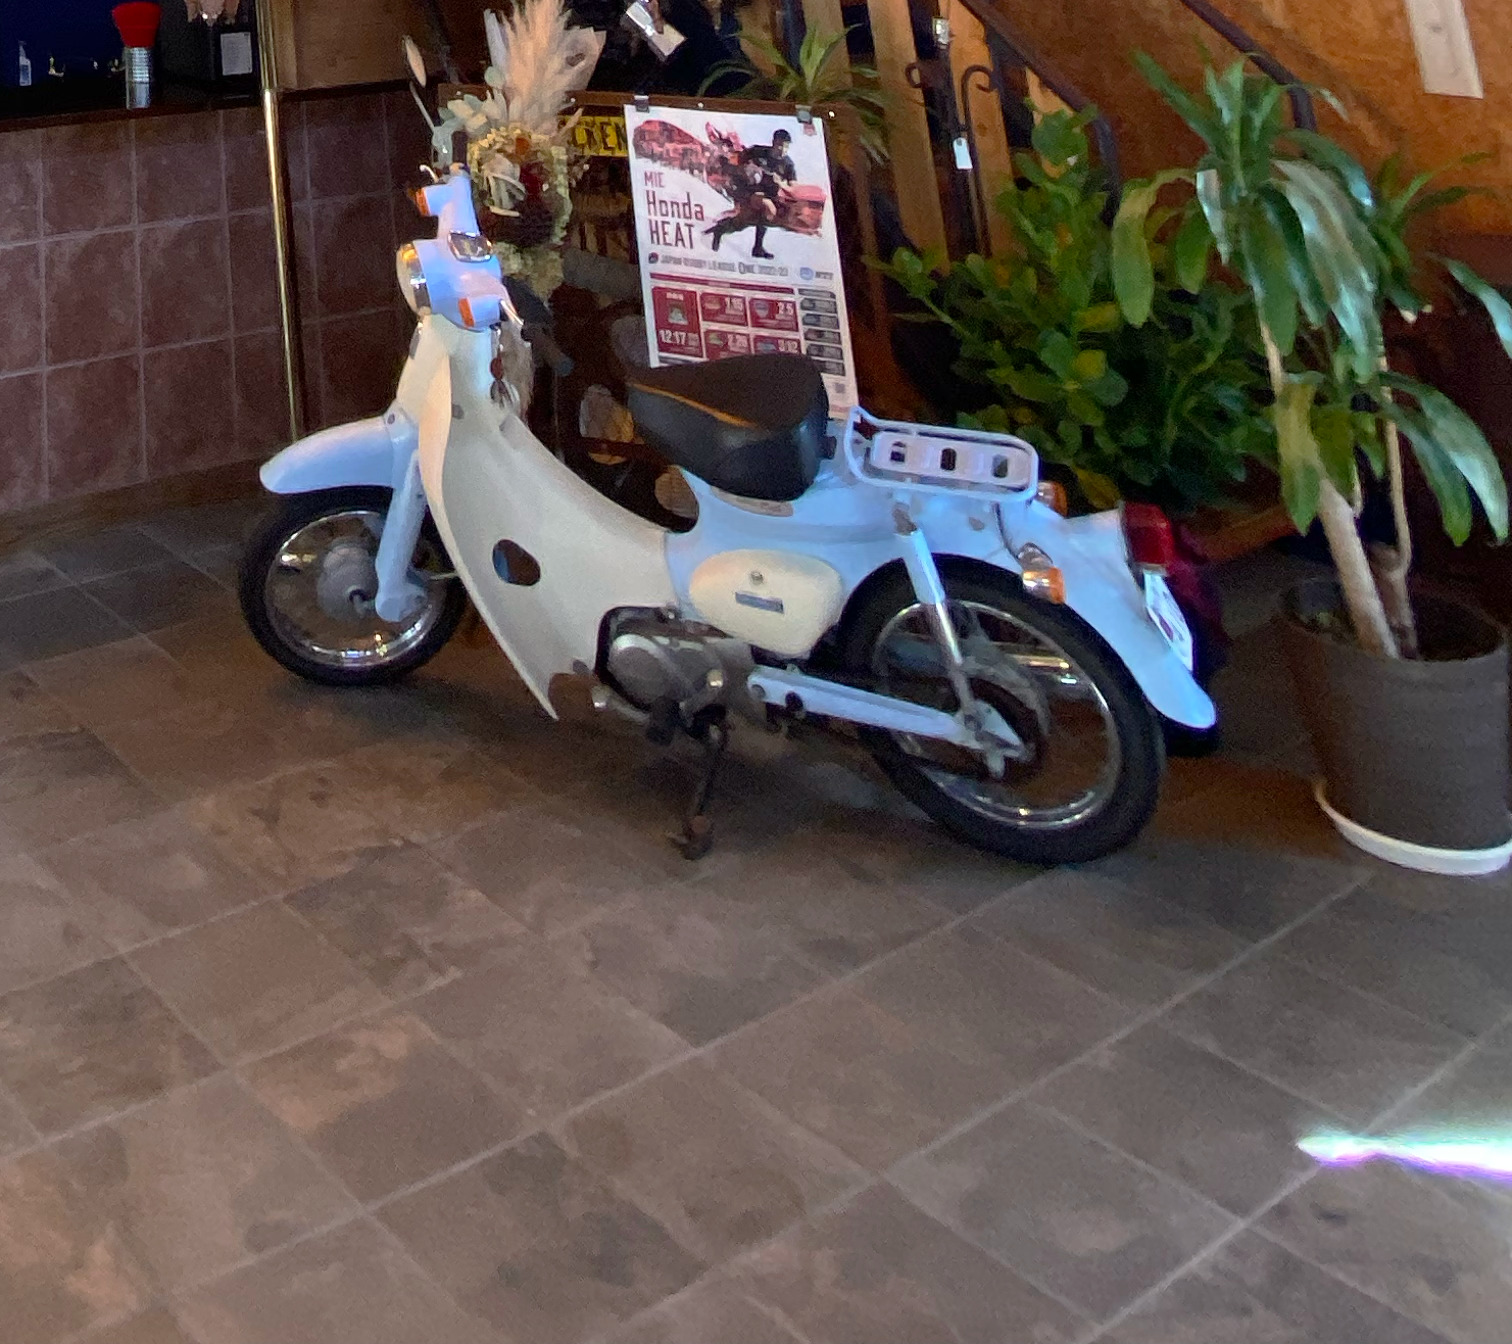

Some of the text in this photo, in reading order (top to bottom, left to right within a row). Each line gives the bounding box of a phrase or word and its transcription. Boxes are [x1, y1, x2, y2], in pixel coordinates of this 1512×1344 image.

[644, 170, 665, 188] MIE
[645, 190, 706, 222] Honda
[648, 218, 696, 250] HEAT
